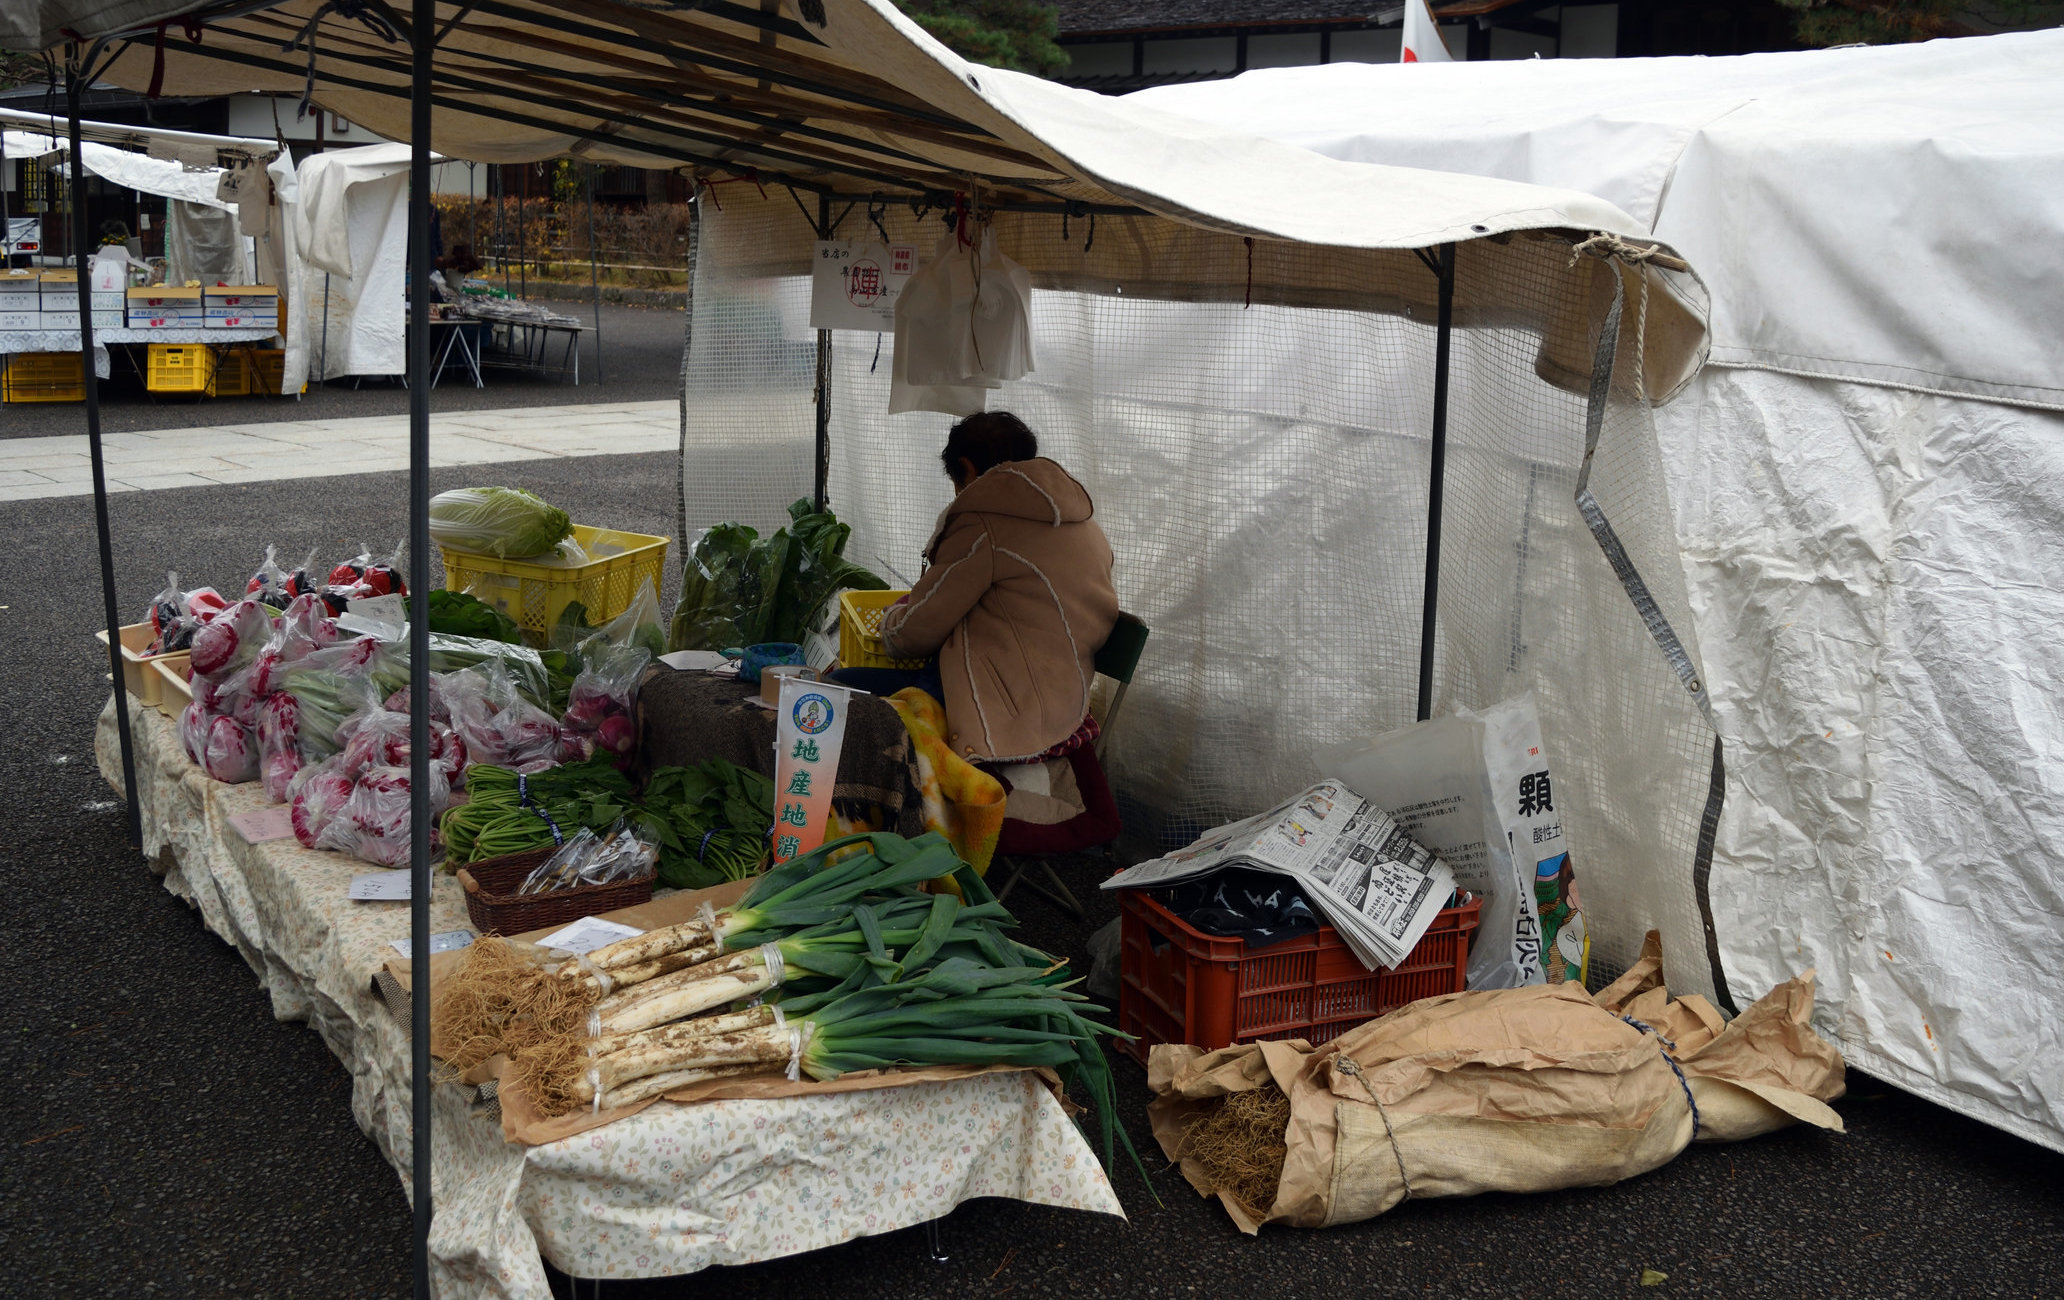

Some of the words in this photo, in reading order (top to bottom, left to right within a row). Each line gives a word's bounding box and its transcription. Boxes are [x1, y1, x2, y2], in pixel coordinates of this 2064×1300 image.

[777, 737, 821, 859] 地産地消
[1518, 769, 1554, 818] 顆
[1533, 820, 1563, 844] 酸性土
